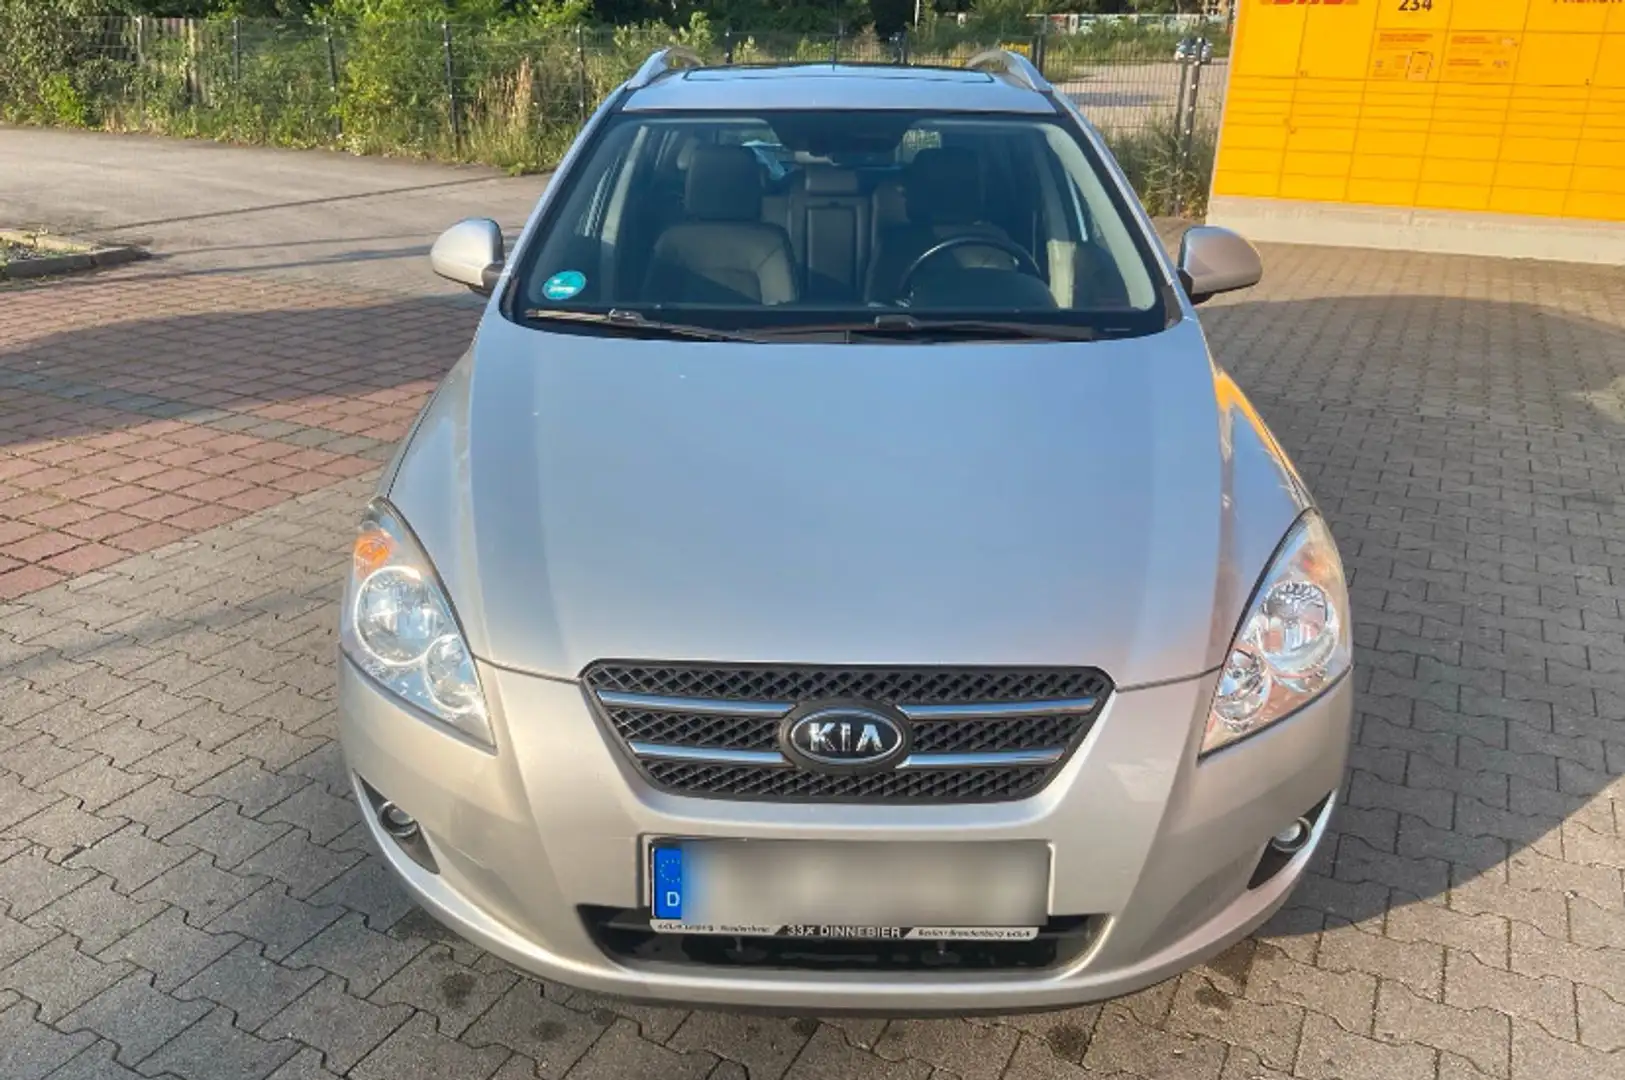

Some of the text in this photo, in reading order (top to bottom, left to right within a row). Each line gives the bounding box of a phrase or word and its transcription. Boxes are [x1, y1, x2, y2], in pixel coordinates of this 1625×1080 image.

[1398, 0, 1432, 11] 234
[808, 722, 883, 752] KIA
[666, 891, 681, 907] D
[820, 925, 901, 938] DINNEBIER
